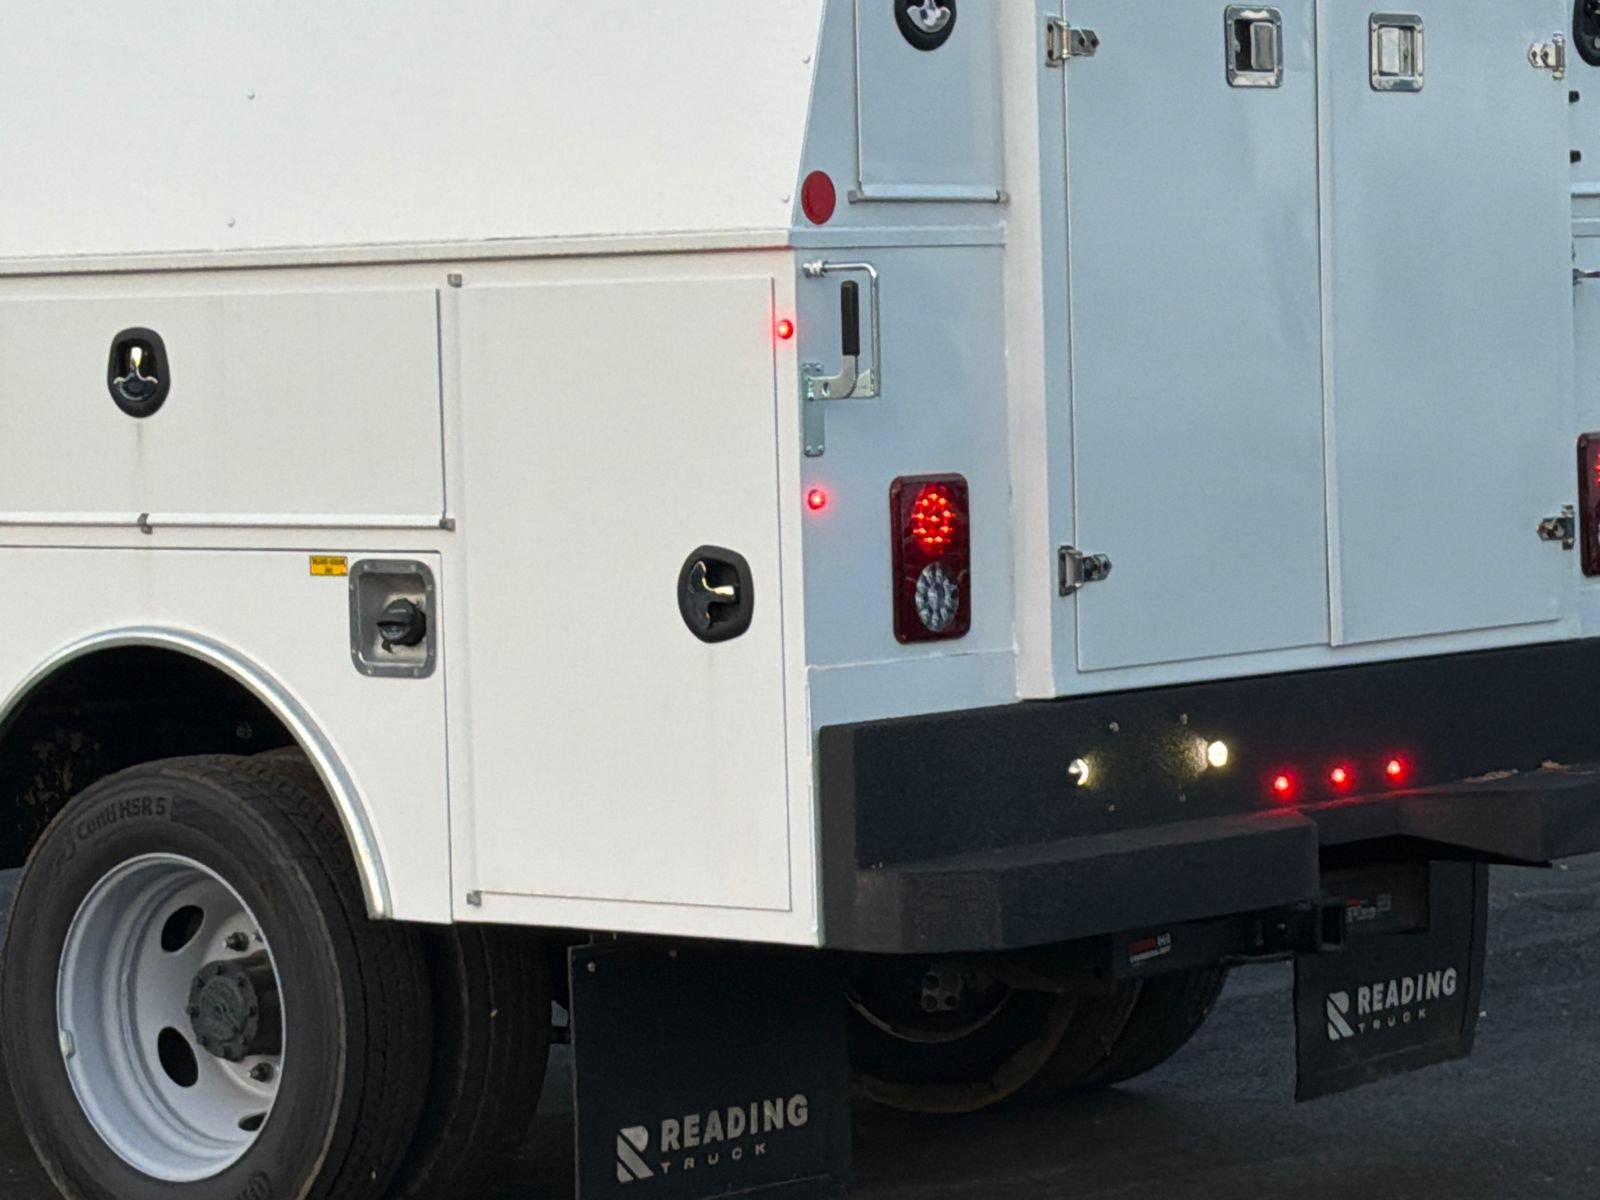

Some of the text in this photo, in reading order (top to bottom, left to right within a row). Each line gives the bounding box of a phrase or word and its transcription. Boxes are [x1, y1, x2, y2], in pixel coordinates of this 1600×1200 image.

[1357, 967, 1457, 1016] READING
[1358, 1008, 1426, 1034] TRUCK
[660, 1093, 808, 1153] READING
[660, 1141, 767, 1175] TRUCK
